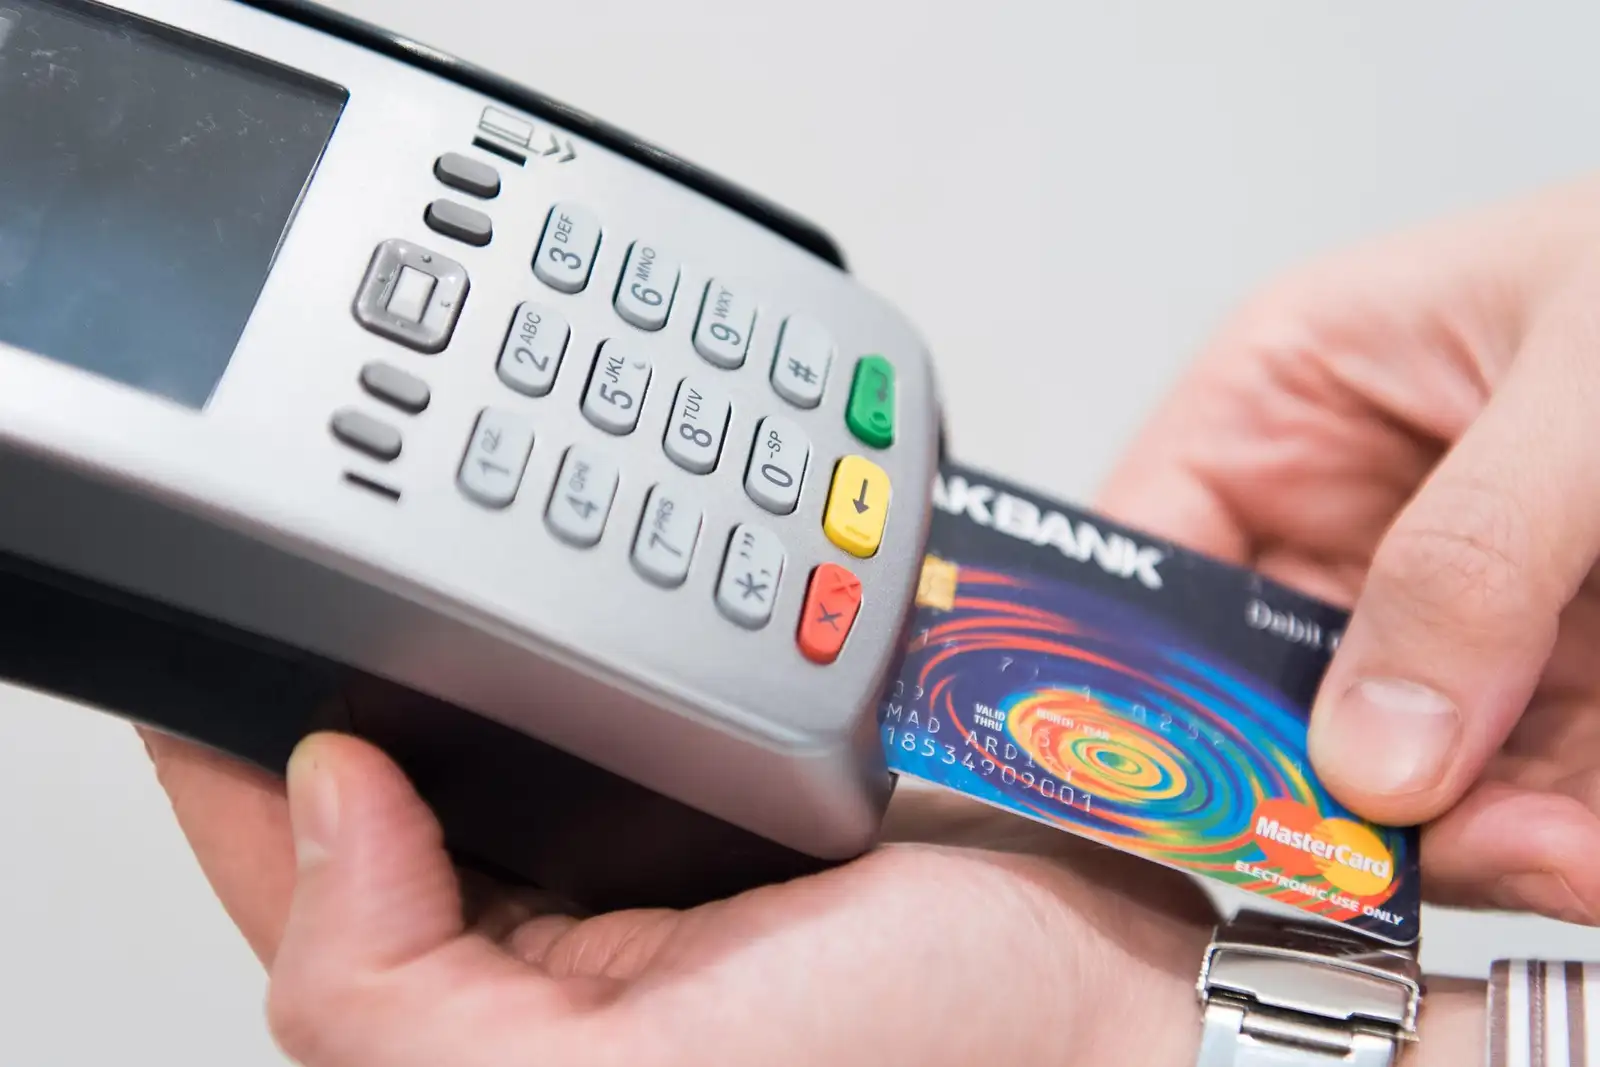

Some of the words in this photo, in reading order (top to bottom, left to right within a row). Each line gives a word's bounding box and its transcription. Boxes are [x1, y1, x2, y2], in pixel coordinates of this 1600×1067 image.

[554, 214, 576, 243] DEF
[549, 247, 582, 270] 3
[634, 247, 656, 282] MNO
[630, 283, 663, 306] 6
[714, 286, 734, 319] WXY
[519, 312, 542, 346] ABC
[710, 322, 741, 346] 9
[514, 346, 549, 372] 2
[602, 355, 625, 384] JKL
[600, 383, 633, 410] 5
[683, 388, 704, 420] TUV
[679, 423, 712, 448] 8
[478, 459, 510, 477] 1
[761, 464, 793, 487] 0
[565, 494, 599, 521] 4
[648, 532, 682, 558] 7
[973, 715, 1003, 732] THRU
[975, 703, 1006, 722] VALID
[1255, 816, 1390, 879] MasterCard
[1234, 860, 1329, 900] ELECTRONIC
[1329, 892, 1360, 912] USE
[1363, 904, 1404, 925] ONLY
